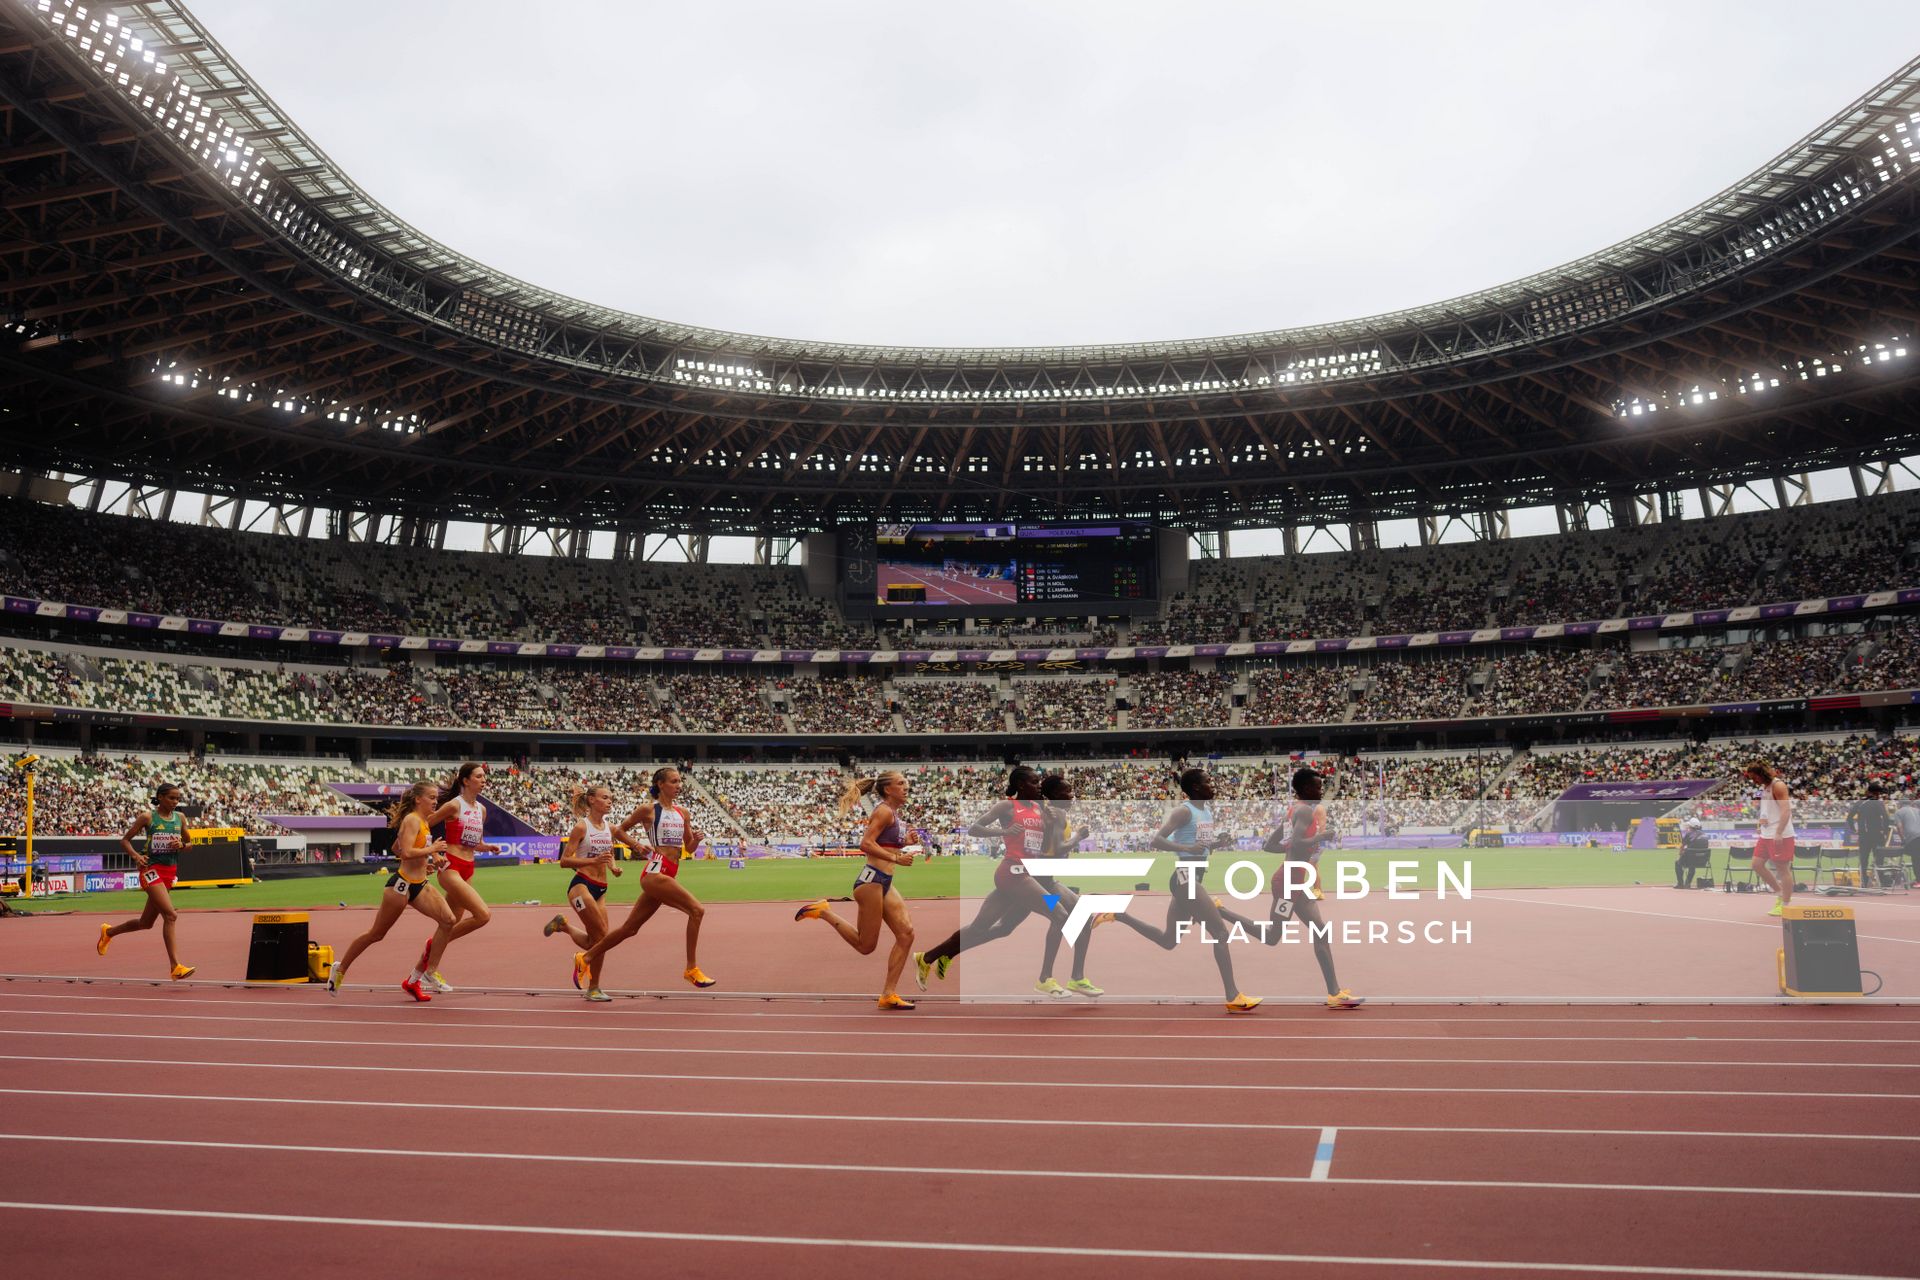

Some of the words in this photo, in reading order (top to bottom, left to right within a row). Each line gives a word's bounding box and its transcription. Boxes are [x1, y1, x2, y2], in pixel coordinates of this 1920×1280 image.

[1022, 817, 1043, 827] KENY
[1501, 834, 1525, 845] TDK
[1566, 833, 1591, 843] TDK
[776, 846, 801, 854] TDK
[650, 861, 659, 872] 7
[145, 870, 157, 882] 12
[865, 870, 872, 881] 1
[91, 878, 106, 889] TDK
[397, 881, 406, 893] 8
[575, 899, 582, 909] 4
[1278, 902, 1287, 913] 6
[1802, 910, 1844, 918] SEIKO
